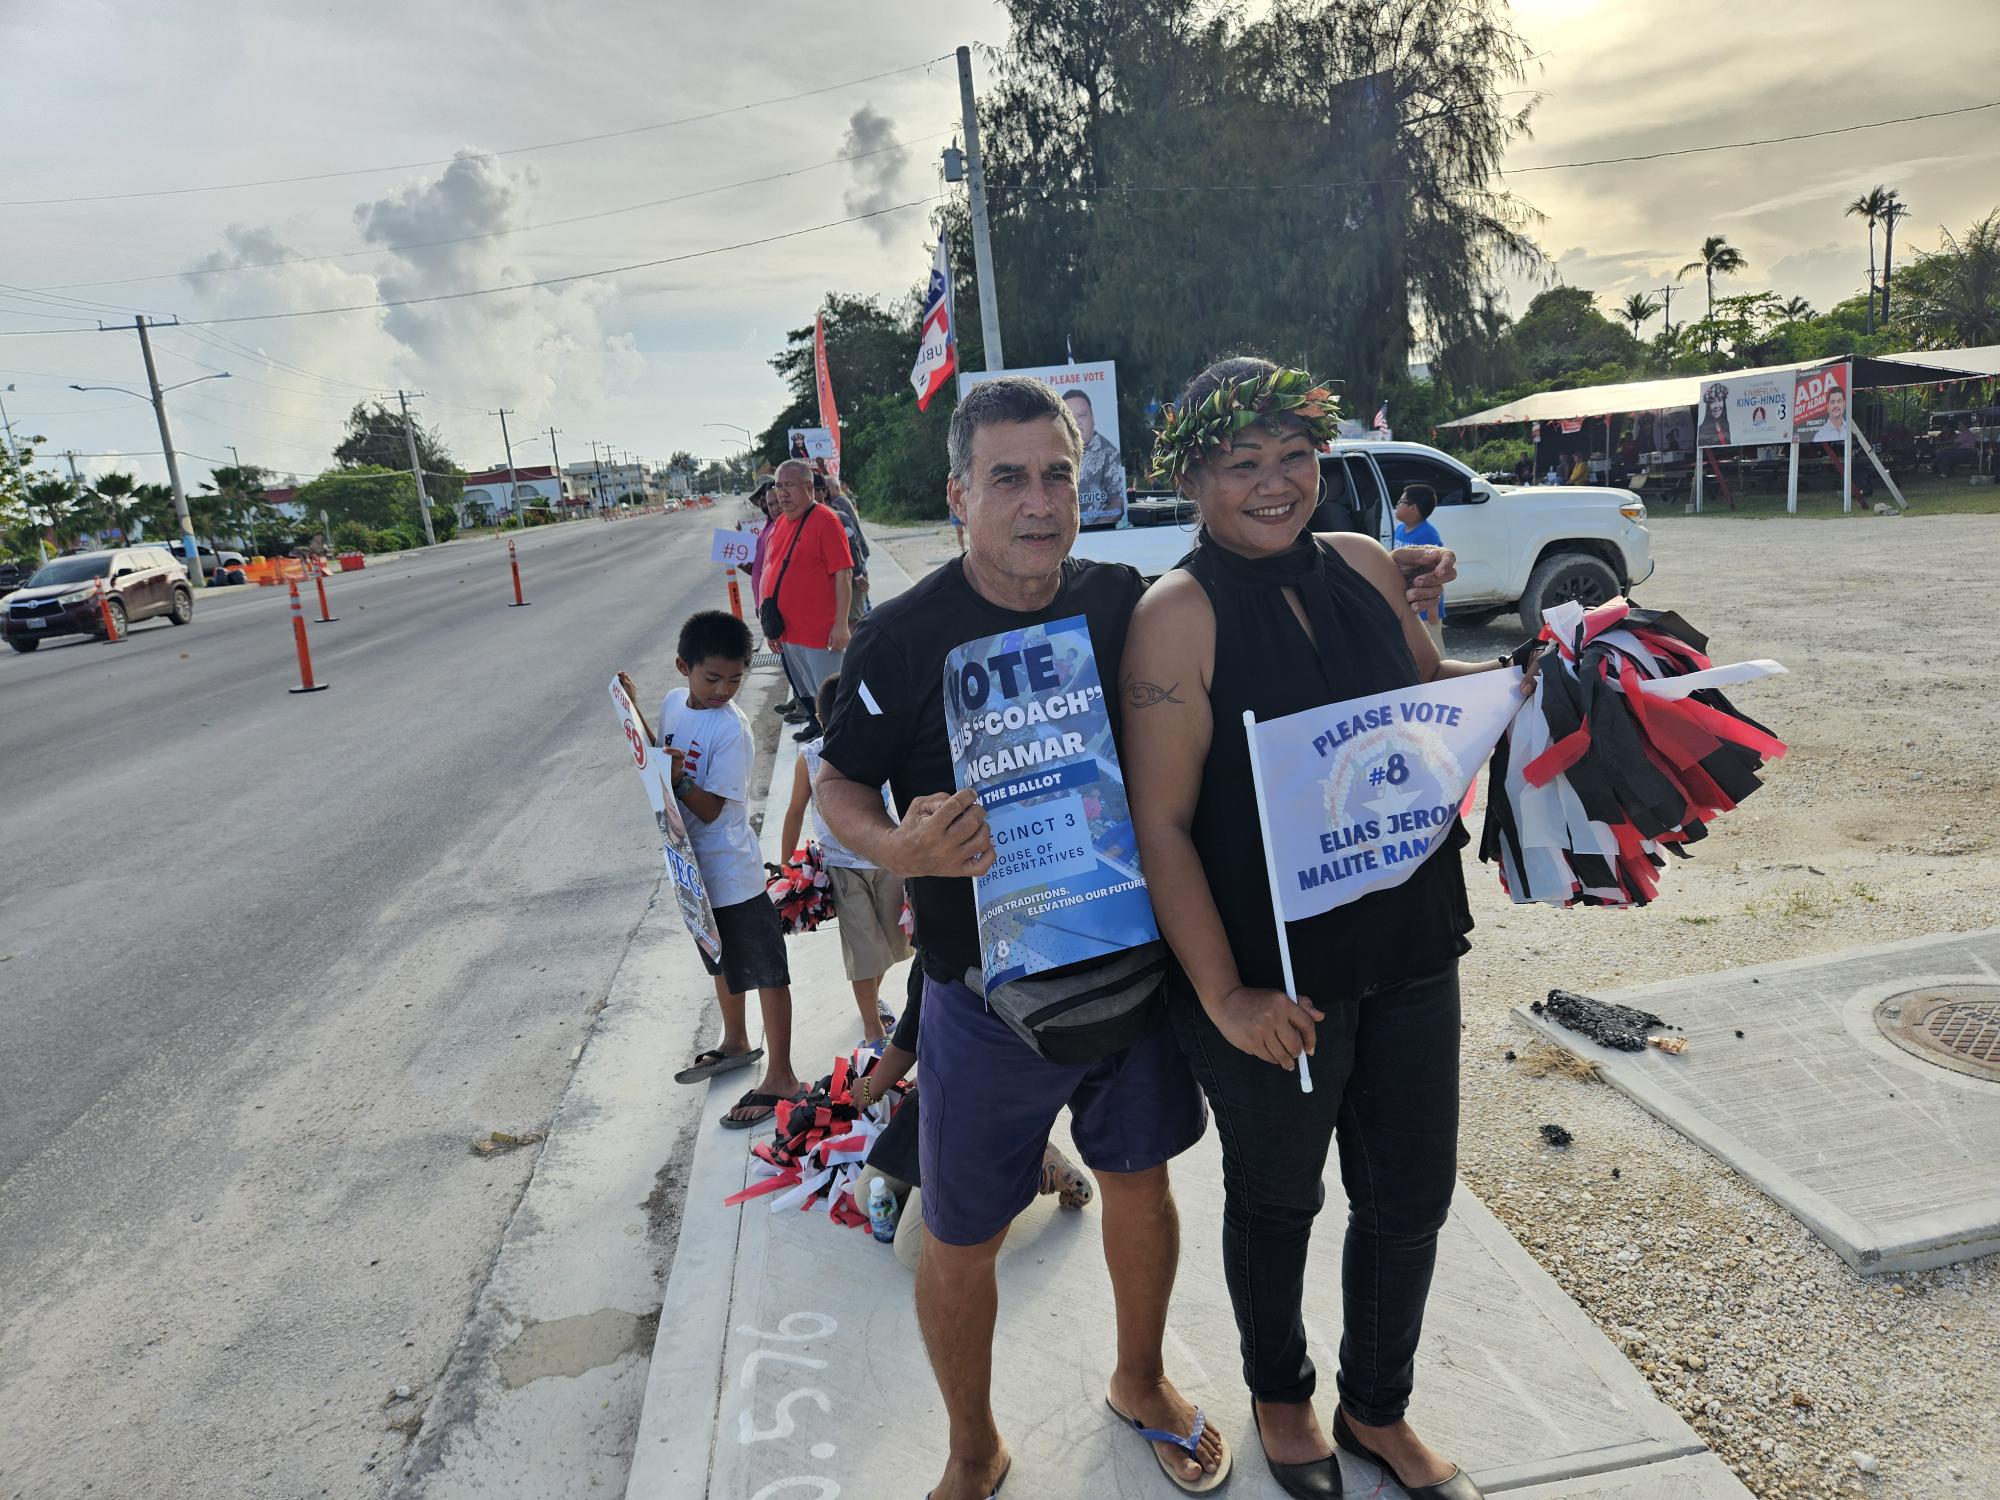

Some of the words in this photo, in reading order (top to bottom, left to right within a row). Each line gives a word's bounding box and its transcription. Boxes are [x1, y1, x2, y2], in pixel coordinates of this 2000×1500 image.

[1050, 374, 1081, 385] PLEASE
[1083, 371, 1105, 381] VOTE
[1796, 372, 1838, 405] ADA
[1736, 394, 1786, 407] KING-HINDS
[1079, 491, 1107, 503] ervice
[723, 542, 748, 561] #9
[948, 643, 1061, 719] VOTE
[1312, 705, 1393, 757] PLEASE
[1400, 702, 1463, 727] VOTE
[1369, 754, 1409, 786] #8
[984, 787, 1008, 804] THE
[1009, 773, 1062, 796] BALLOT
[990, 817, 1055, 847] CINCT
[1065, 813, 1076, 827] 3
[1320, 820, 1380, 854] ELIAS
[1037, 842, 1053, 855] OF
[978, 847, 1085, 889] REPRESENTATIVES
[1298, 850, 1378, 891] MALITE
[987, 905, 1004, 919] OUR
[1004, 887, 1071, 911] TRADITIONS.
[1028, 894, 1085, 916] ELEVATING
[1085, 890, 1108, 900] OUR
[998, 940, 1010, 957] 8
